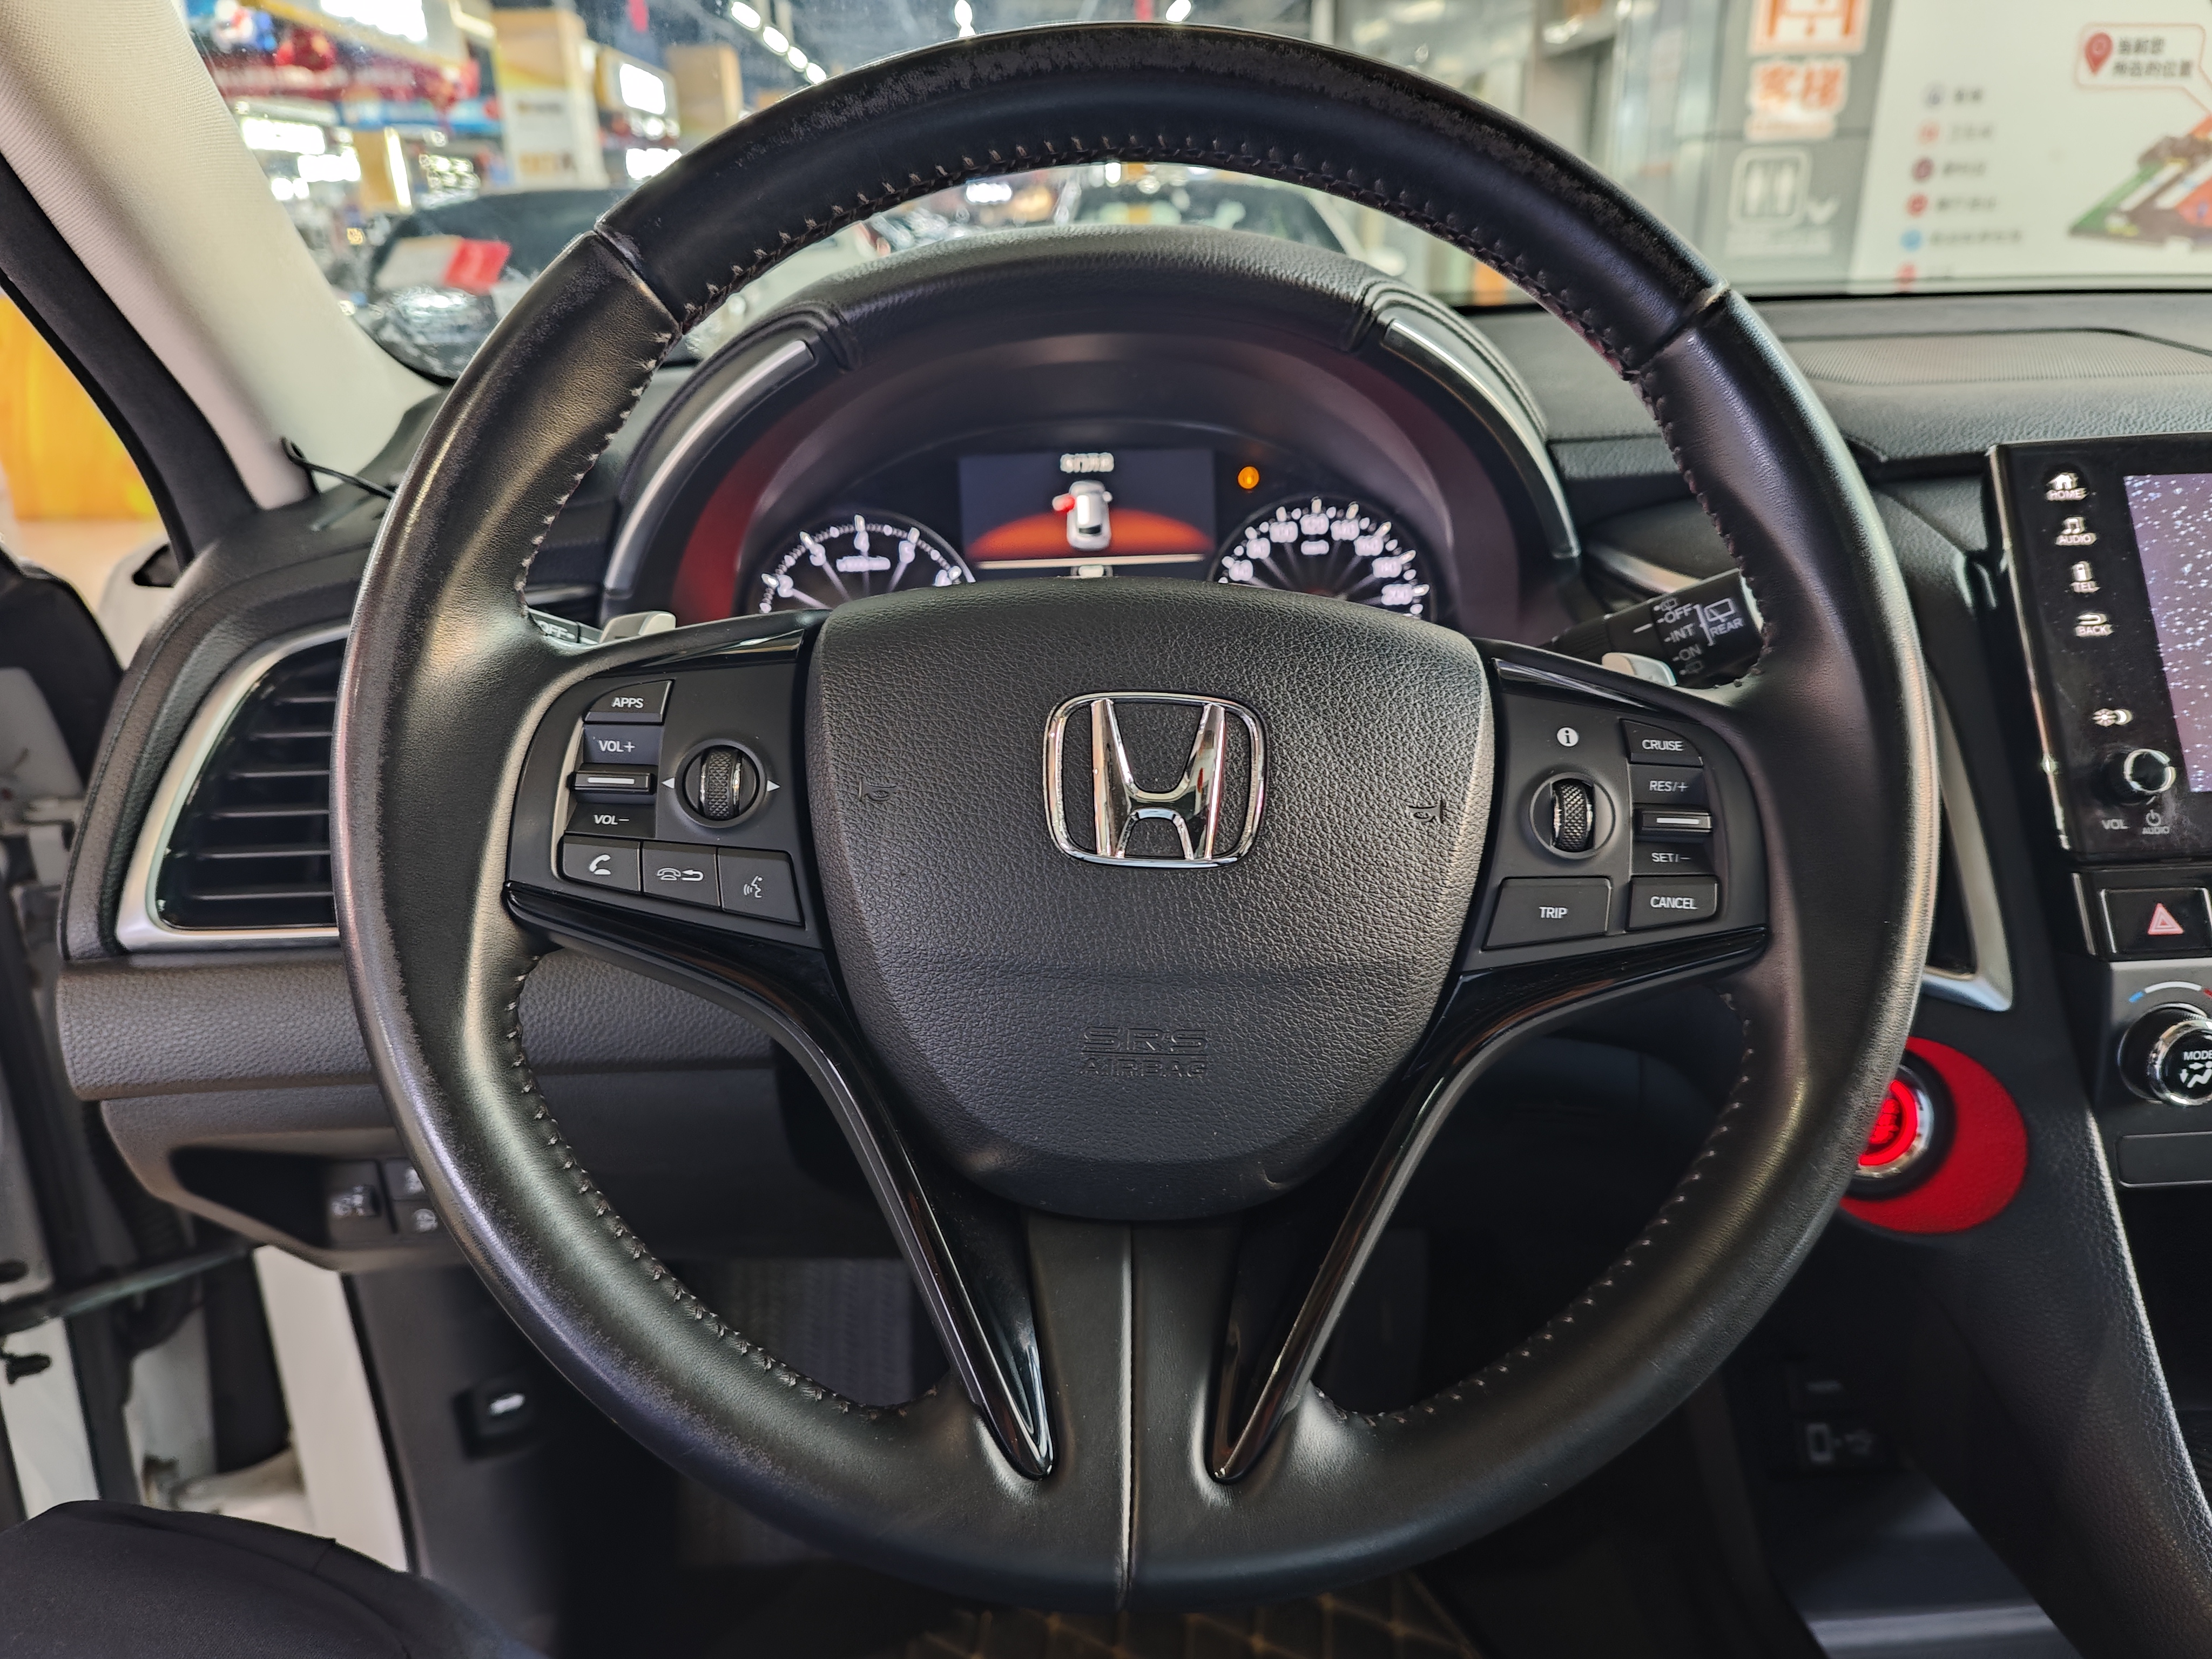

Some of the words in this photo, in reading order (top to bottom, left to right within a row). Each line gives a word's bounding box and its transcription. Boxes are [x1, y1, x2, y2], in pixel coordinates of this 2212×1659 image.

[2048, 489, 2085, 500] HOME
[2056, 534, 2095, 545] AUDIO
[2072, 581, 2099, 592] TEL
[1664, 603, 1693, 623] OFF
[1670, 623, 1695, 643] INT
[1710, 618, 1745, 637] REAR
[2076, 624, 2111, 637] BACK
[1679, 644, 1702, 660] ON
[611, 697, 644, 708] APPS
[599, 740, 635, 752] VOL+
[1642, 739, 1684, 751] CRUISE
[1649, 780, 1689, 792] RES/+
[2101, 819, 2130, 830] VOL
[2142, 826, 2170, 835] AUDIO
[1650, 896, 1698, 909] CANCEL
[1539, 907, 1568, 919] TRIP
[1083, 1027, 1208, 1051] SRS
[2183, 1050, 2212, 1061] MODE
[1081, 1057, 1208, 1078] AIRBAG
